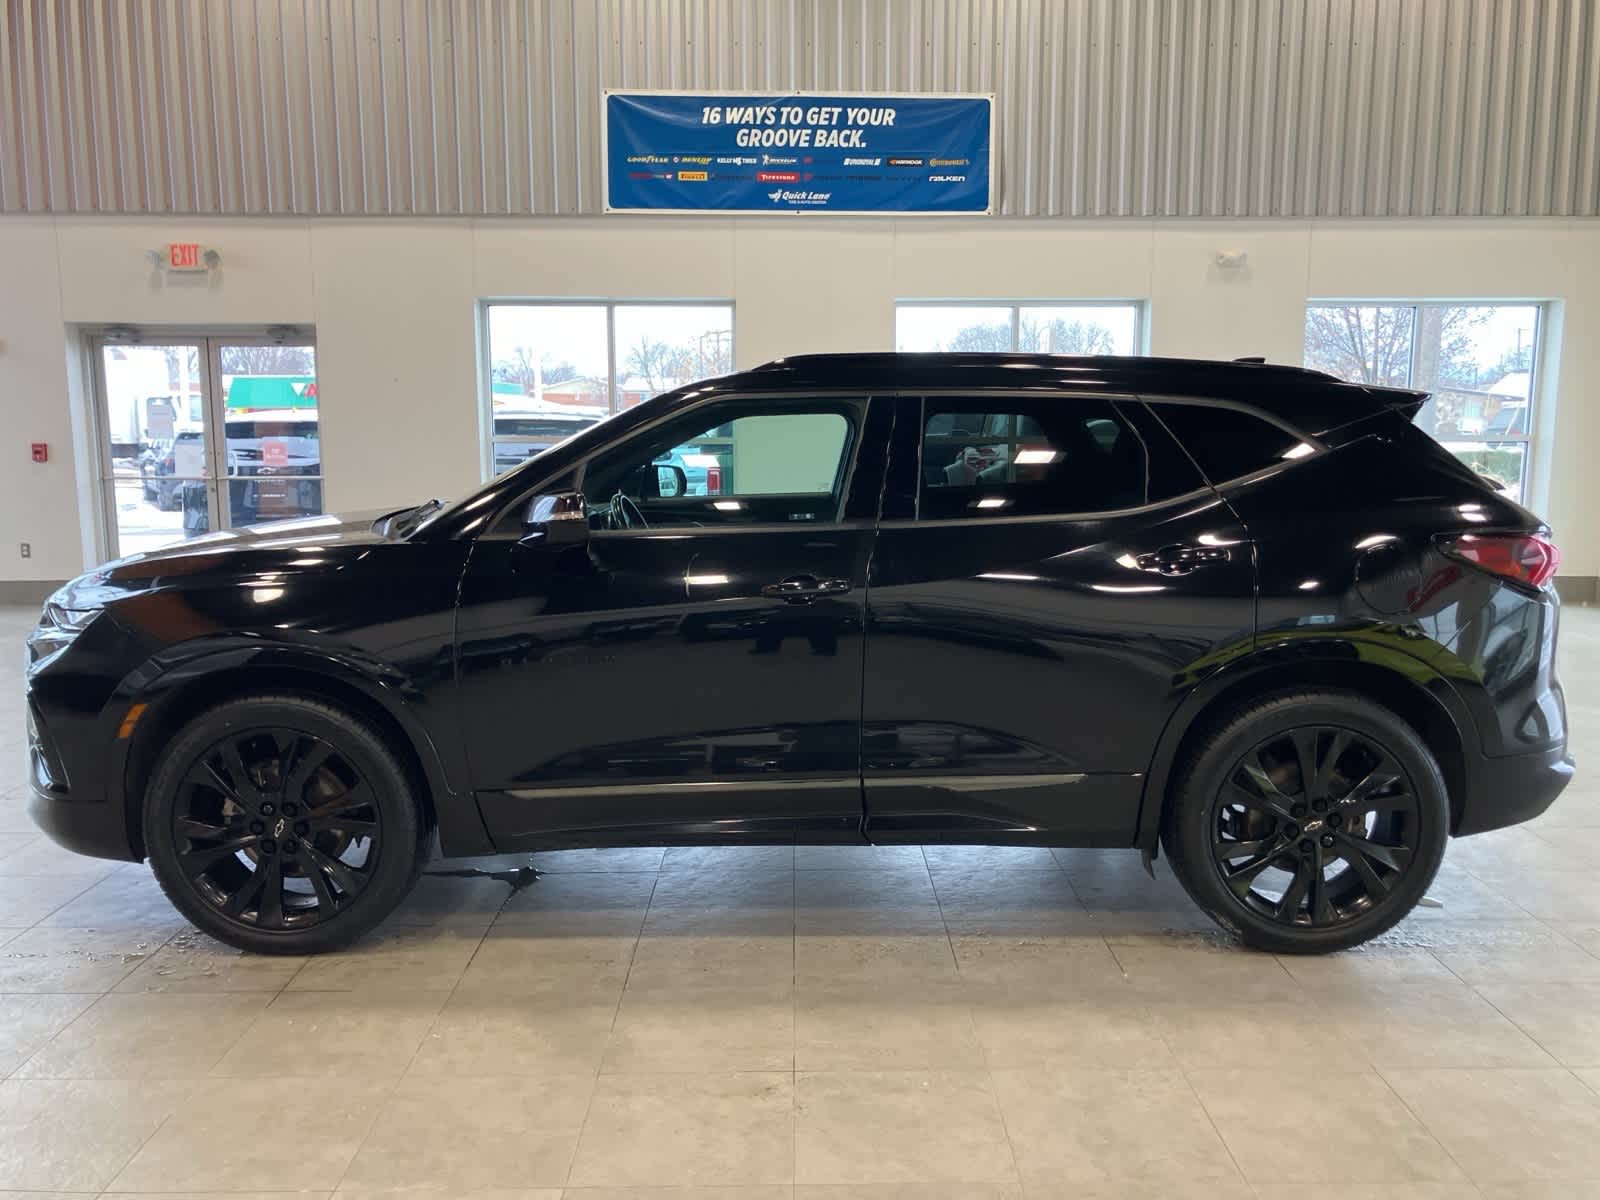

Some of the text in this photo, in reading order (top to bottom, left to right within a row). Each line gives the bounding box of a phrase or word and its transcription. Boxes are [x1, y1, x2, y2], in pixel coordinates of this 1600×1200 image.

[702, 107, 897, 126] 16 WAYS TO GET YOUR
[736, 128, 867, 148] GROOVE BACK.
[782, 191, 831, 200] Quick Lane
[170, 243, 199, 267] EXIT
